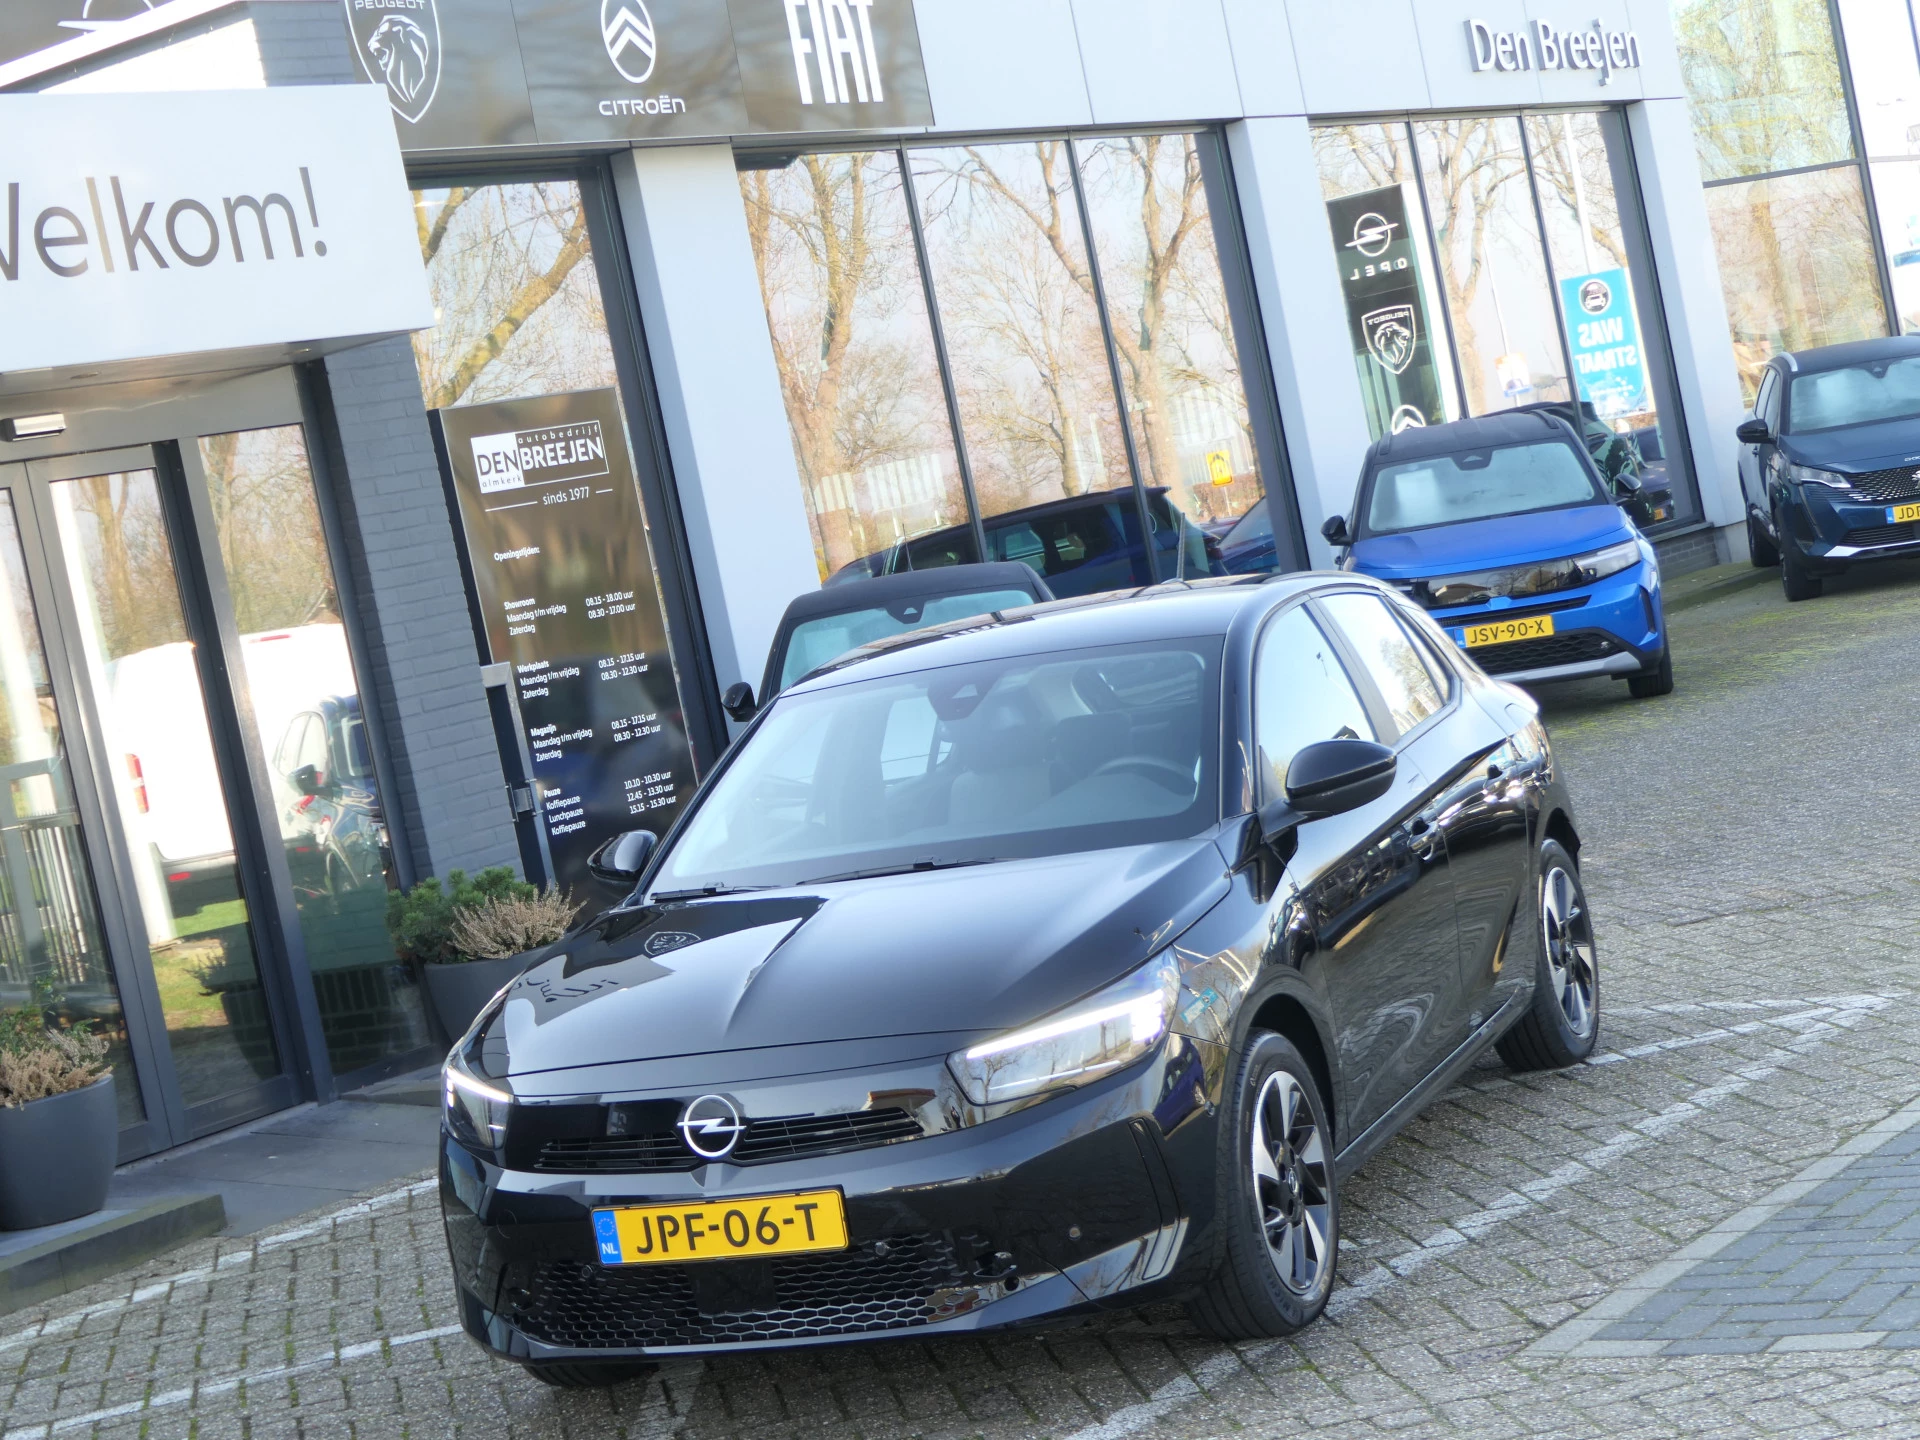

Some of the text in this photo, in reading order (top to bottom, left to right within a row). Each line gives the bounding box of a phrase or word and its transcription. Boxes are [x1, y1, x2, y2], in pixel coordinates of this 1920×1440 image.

[355, 0, 425, 10] PEUGEOT
[784, 0, 883, 104] FIAT
[1463, 18, 1643, 86] Den Breejen
[518, 424, 598, 444] autobedrijf
[482, 475, 522, 488] almkerk
[542, 486, 590, 506] sinds 1977
[494, 546, 540, 562] Openingstijden:
[504, 598, 536, 610] Showroom
[585, 596, 602, 606] 08.15
[606, 592, 622, 602] 18.00
[623, 591, 634, 599] uur
[507, 605, 567, 623] Maandag t/m vrijdag
[588, 608, 605, 619] 08.30
[609, 604, 625, 614] 17.00
[625, 603, 636, 612] uur
[509, 624, 536, 636] Zaterdag
[1470, 619, 1545, 644] JSV-90-X
[517, 660, 549, 673] Werkplaats
[598, 658, 615, 668] 08.15
[620, 653, 634, 663] 17.15
[635, 652, 645, 660] uur
[520, 667, 580, 686] Maandag t/m vrijdag
[601, 670, 618, 680] 08.30
[622, 665, 637, 676] 12.30
[638, 664, 648, 672] uur
[522, 687, 549, 699] Zaterdag
[612, 719, 628, 730] 08.15
[631, 714, 646, 725] 17.15
[646, 713, 656, 721] uur
[530, 724, 557, 736] Magazijn
[614, 731, 631, 742] 08.30
[635, 726, 650, 737] 12.30
[651, 725, 661, 733] uur
[533, 729, 593, 749] Maandag t/m vrijdag
[536, 750, 562, 762] Zaterdag
[624, 778, 641, 789] 10.10
[644, 773, 660, 784] 10.30
[661, 772, 672, 780] uur
[544, 788, 561, 798] Pauze
[627, 791, 643, 802] 12.45
[647, 785, 663, 796] 13.30
[663, 784, 674, 792] uur
[546, 796, 580, 810] Koffiepauze
[629, 803, 645, 814] 15.15
[650, 797, 666, 809] 15.30
[666, 796, 677, 804] uur
[549, 808, 584, 823] Lunchpauze
[551, 820, 586, 836] Koffiepauze
[601, 1203, 819, 1255] NL JPF-06-T
